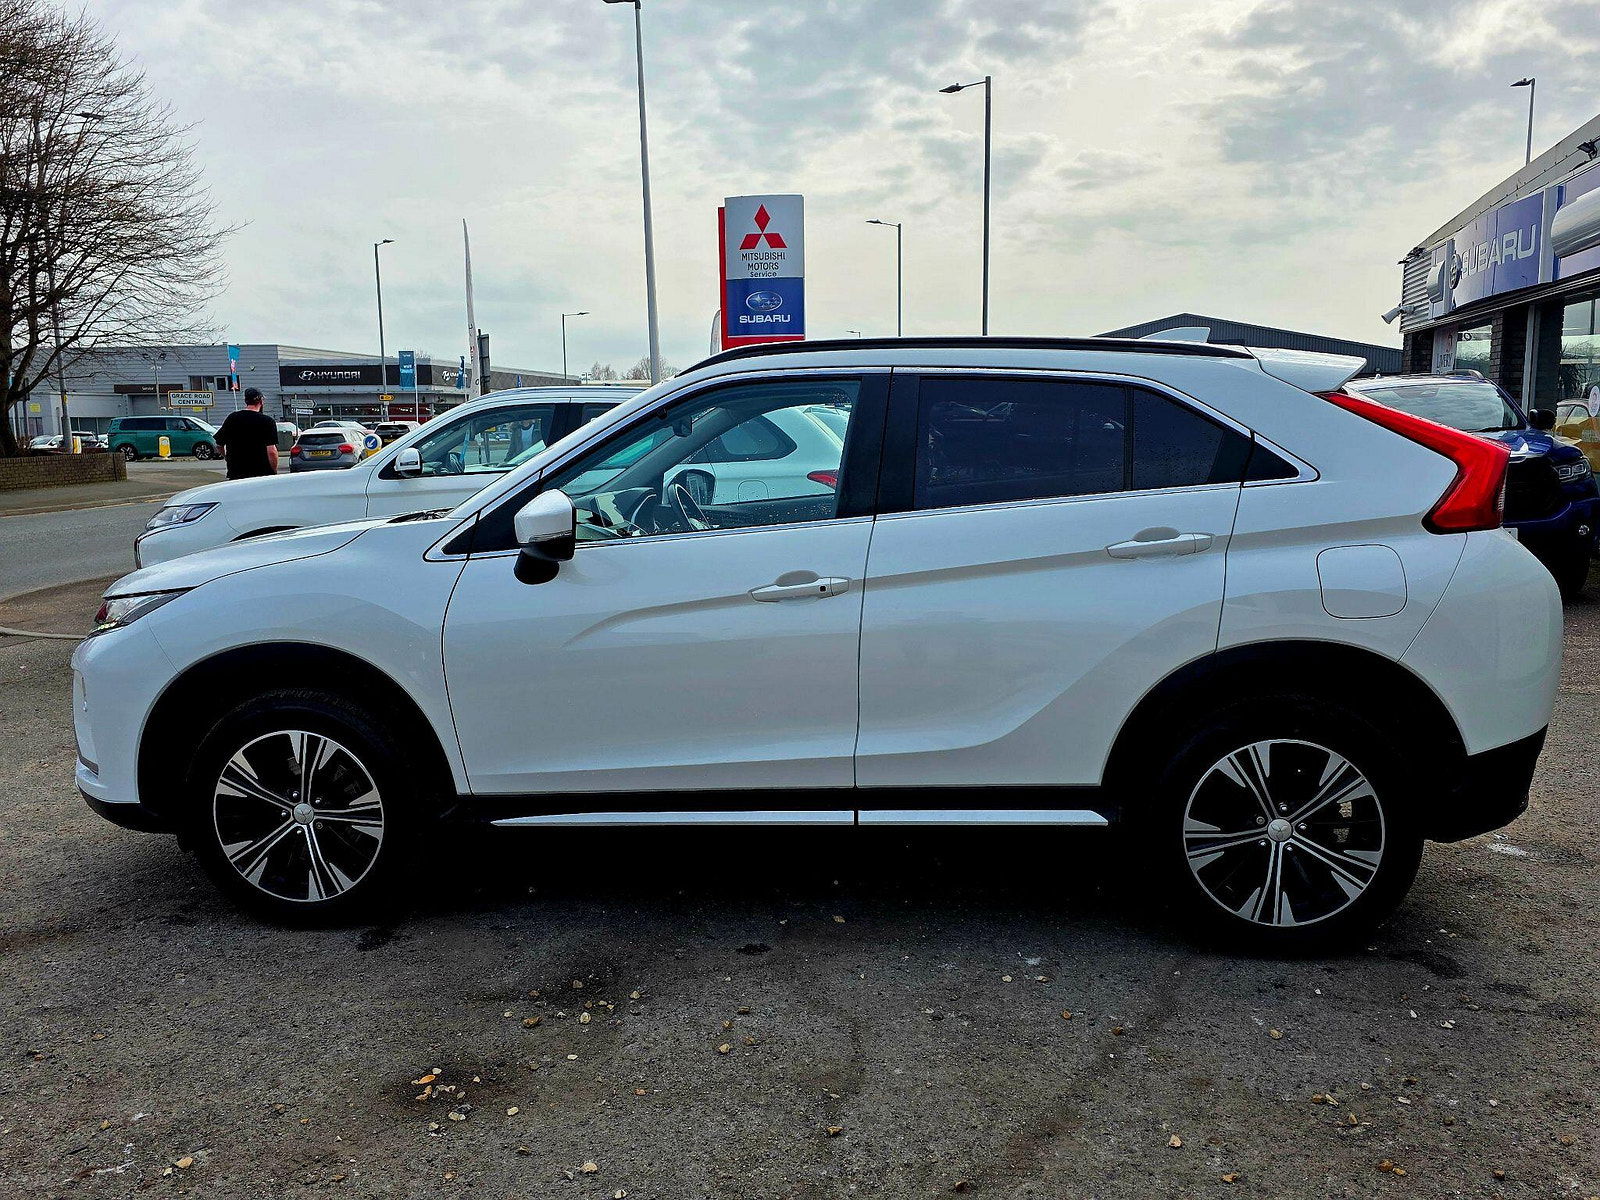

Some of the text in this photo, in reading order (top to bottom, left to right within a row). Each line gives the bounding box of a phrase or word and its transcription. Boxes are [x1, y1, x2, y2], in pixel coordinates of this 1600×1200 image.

[1461, 224, 1537, 279] SUBARU
[741, 252, 786, 261] MITSUBISHI
[747, 262, 779, 271] MOTORS
[739, 314, 791, 324] SUBARU
[316, 371, 361, 380] HYUNDAI
